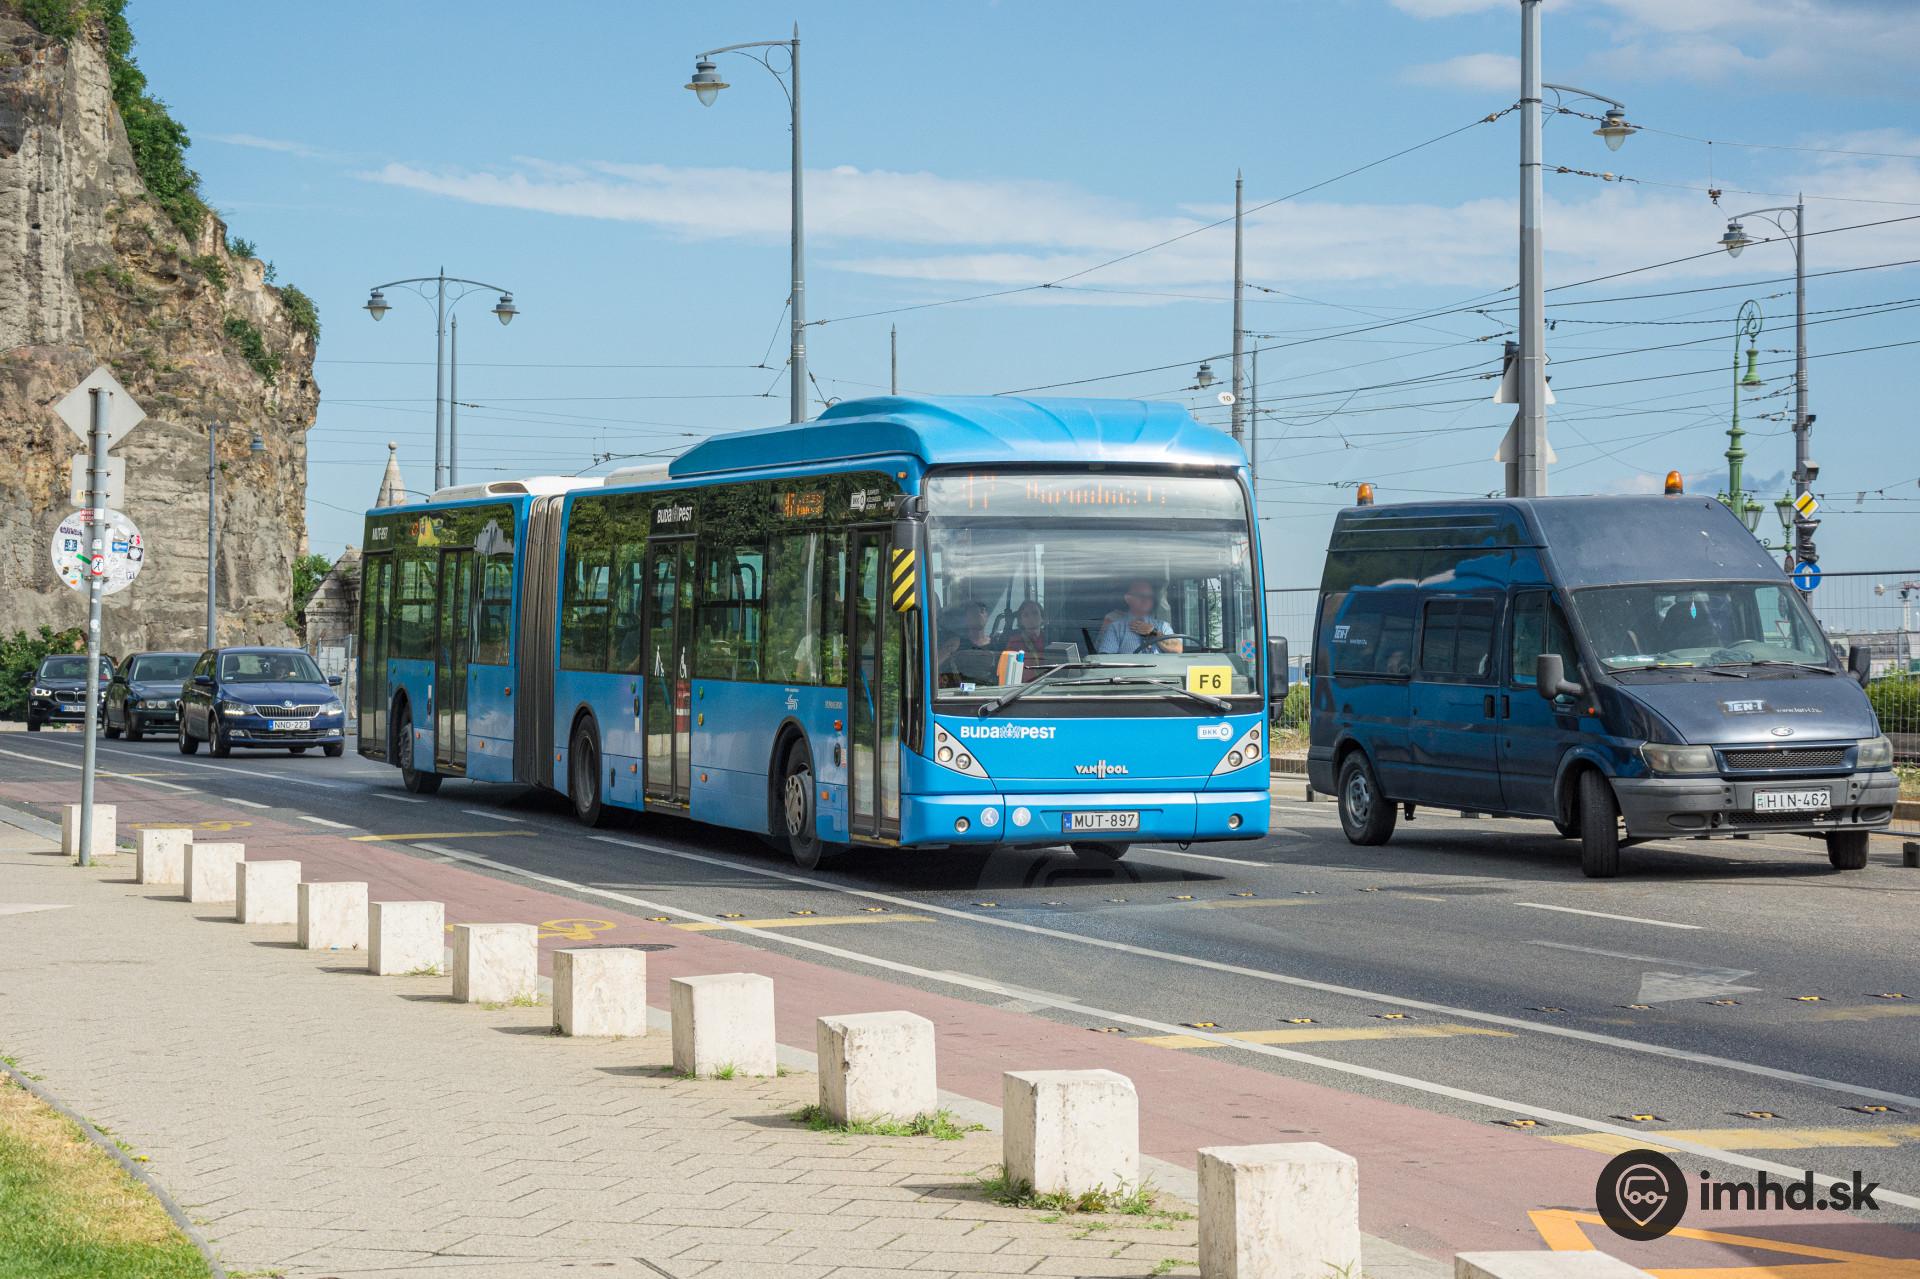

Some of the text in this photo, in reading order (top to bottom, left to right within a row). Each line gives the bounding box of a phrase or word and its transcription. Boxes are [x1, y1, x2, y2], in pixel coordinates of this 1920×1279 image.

[1723, 699, 1765, 712] TEN-T
[1767, 792, 1828, 808] HIN-462
[1074, 814, 1135, 828] MUT-897
